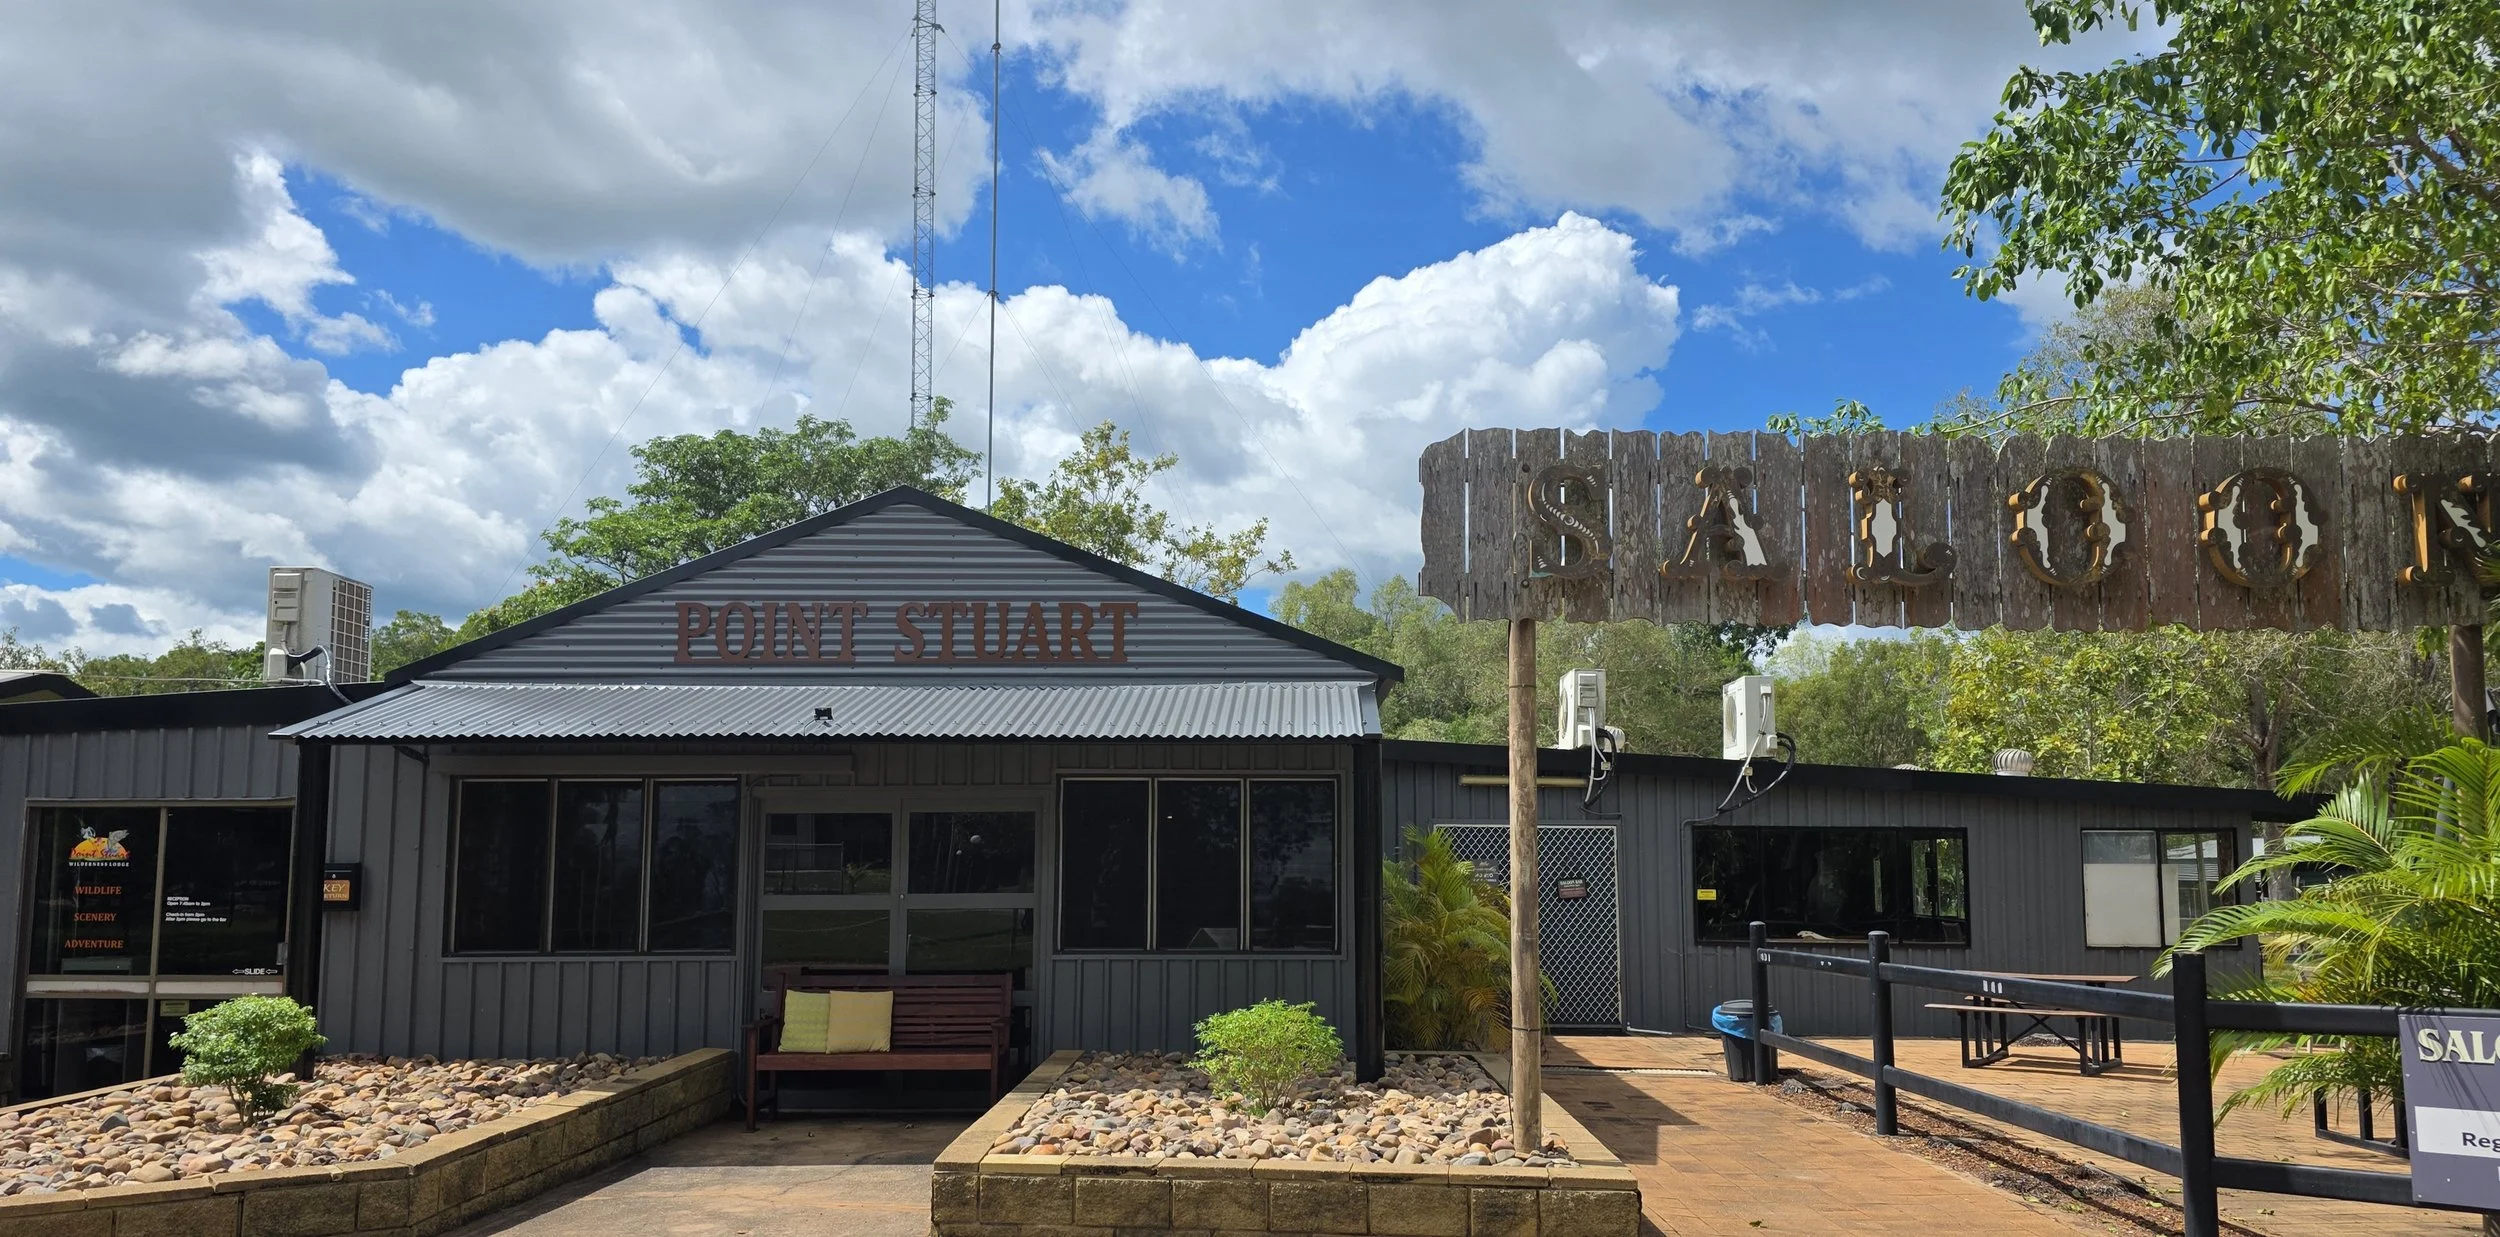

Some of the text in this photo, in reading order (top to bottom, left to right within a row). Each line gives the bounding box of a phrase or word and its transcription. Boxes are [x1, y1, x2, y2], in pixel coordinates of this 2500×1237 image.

[1527, 463, 2500, 588] SALOON
[674, 602, 1138, 663] POINT STUART
[75, 886, 122, 894] WILDLIFE
[324, 883, 346, 893] KEY
[74, 912, 117, 921] SCENERY
[64, 940, 124, 949] ADVENTURE
[2418, 1028, 2500, 1064] SAL
